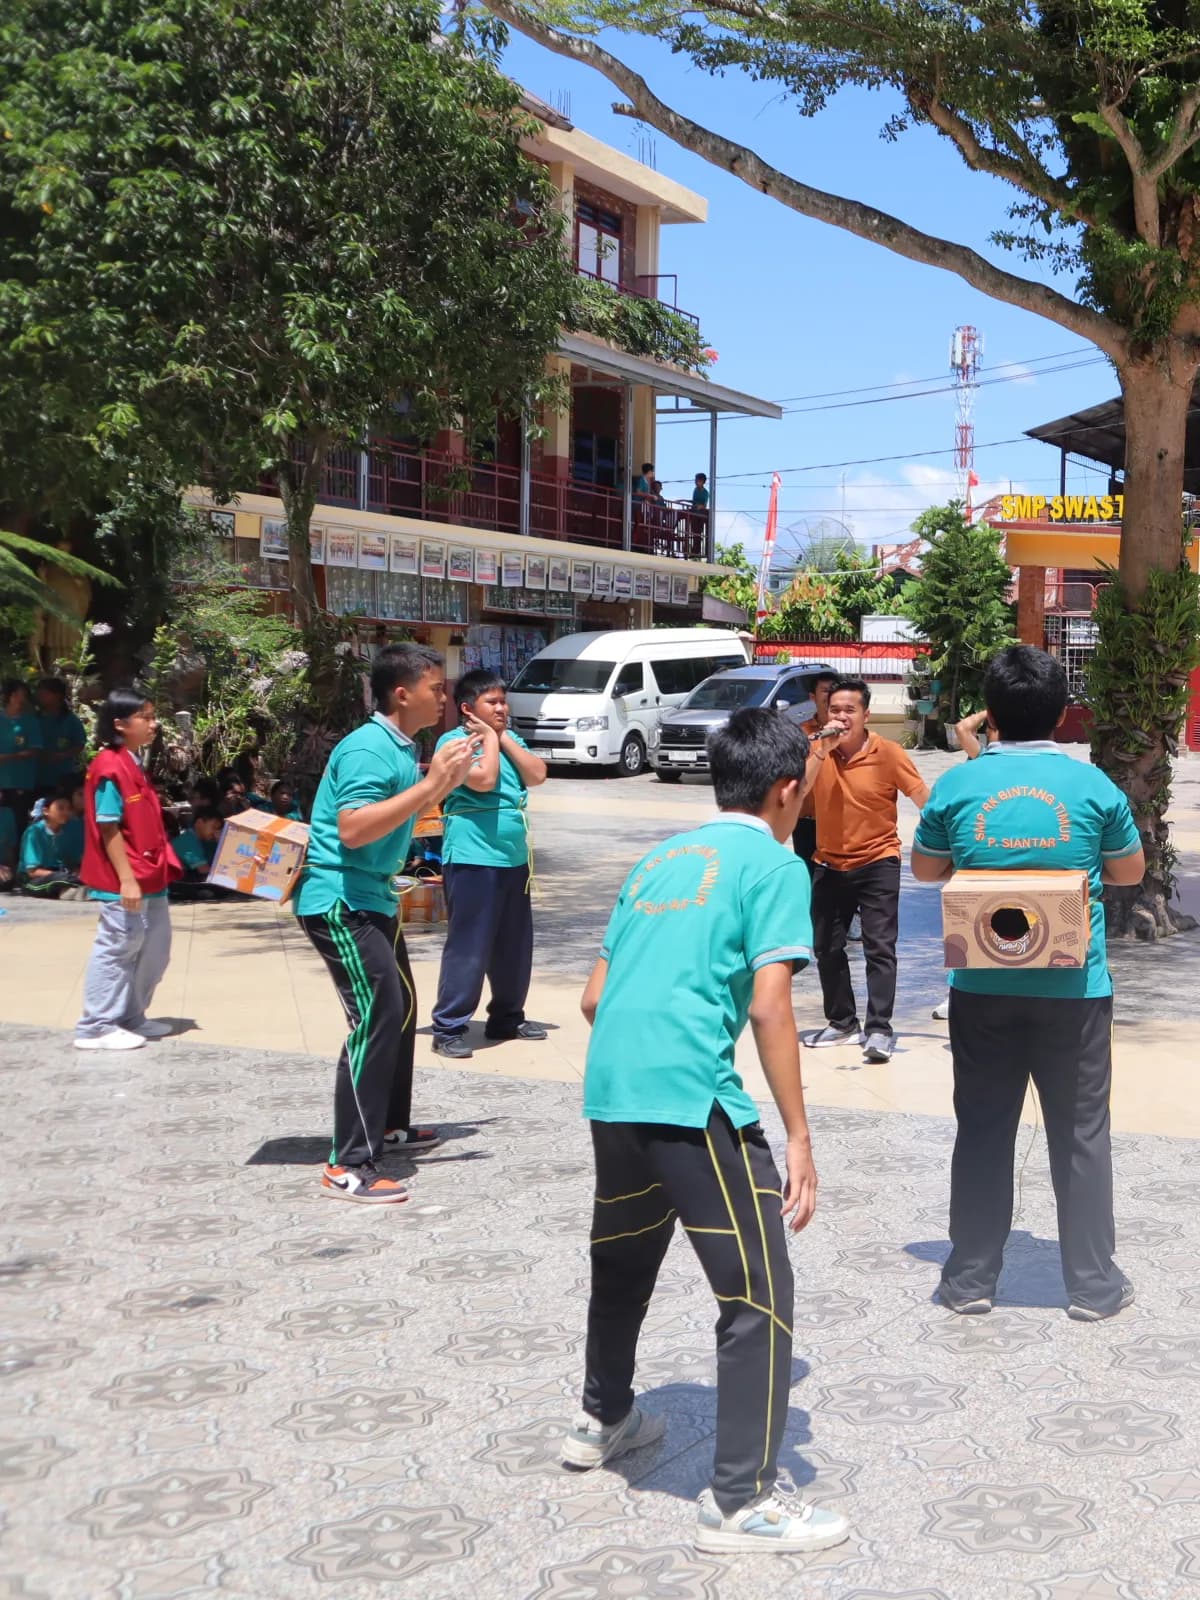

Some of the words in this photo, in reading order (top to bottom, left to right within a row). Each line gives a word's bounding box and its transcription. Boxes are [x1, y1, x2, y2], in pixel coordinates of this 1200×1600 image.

[1001, 495, 1046, 519] SMP
[974, 813, 985, 841] SMP
[982, 796, 999, 812] RK
[998, 786, 1056, 806] BINTANG
[1053, 802, 1071, 842] TIMUR
[987, 838, 999, 848] P.
[1002, 837, 1057, 849] SIANTAR
